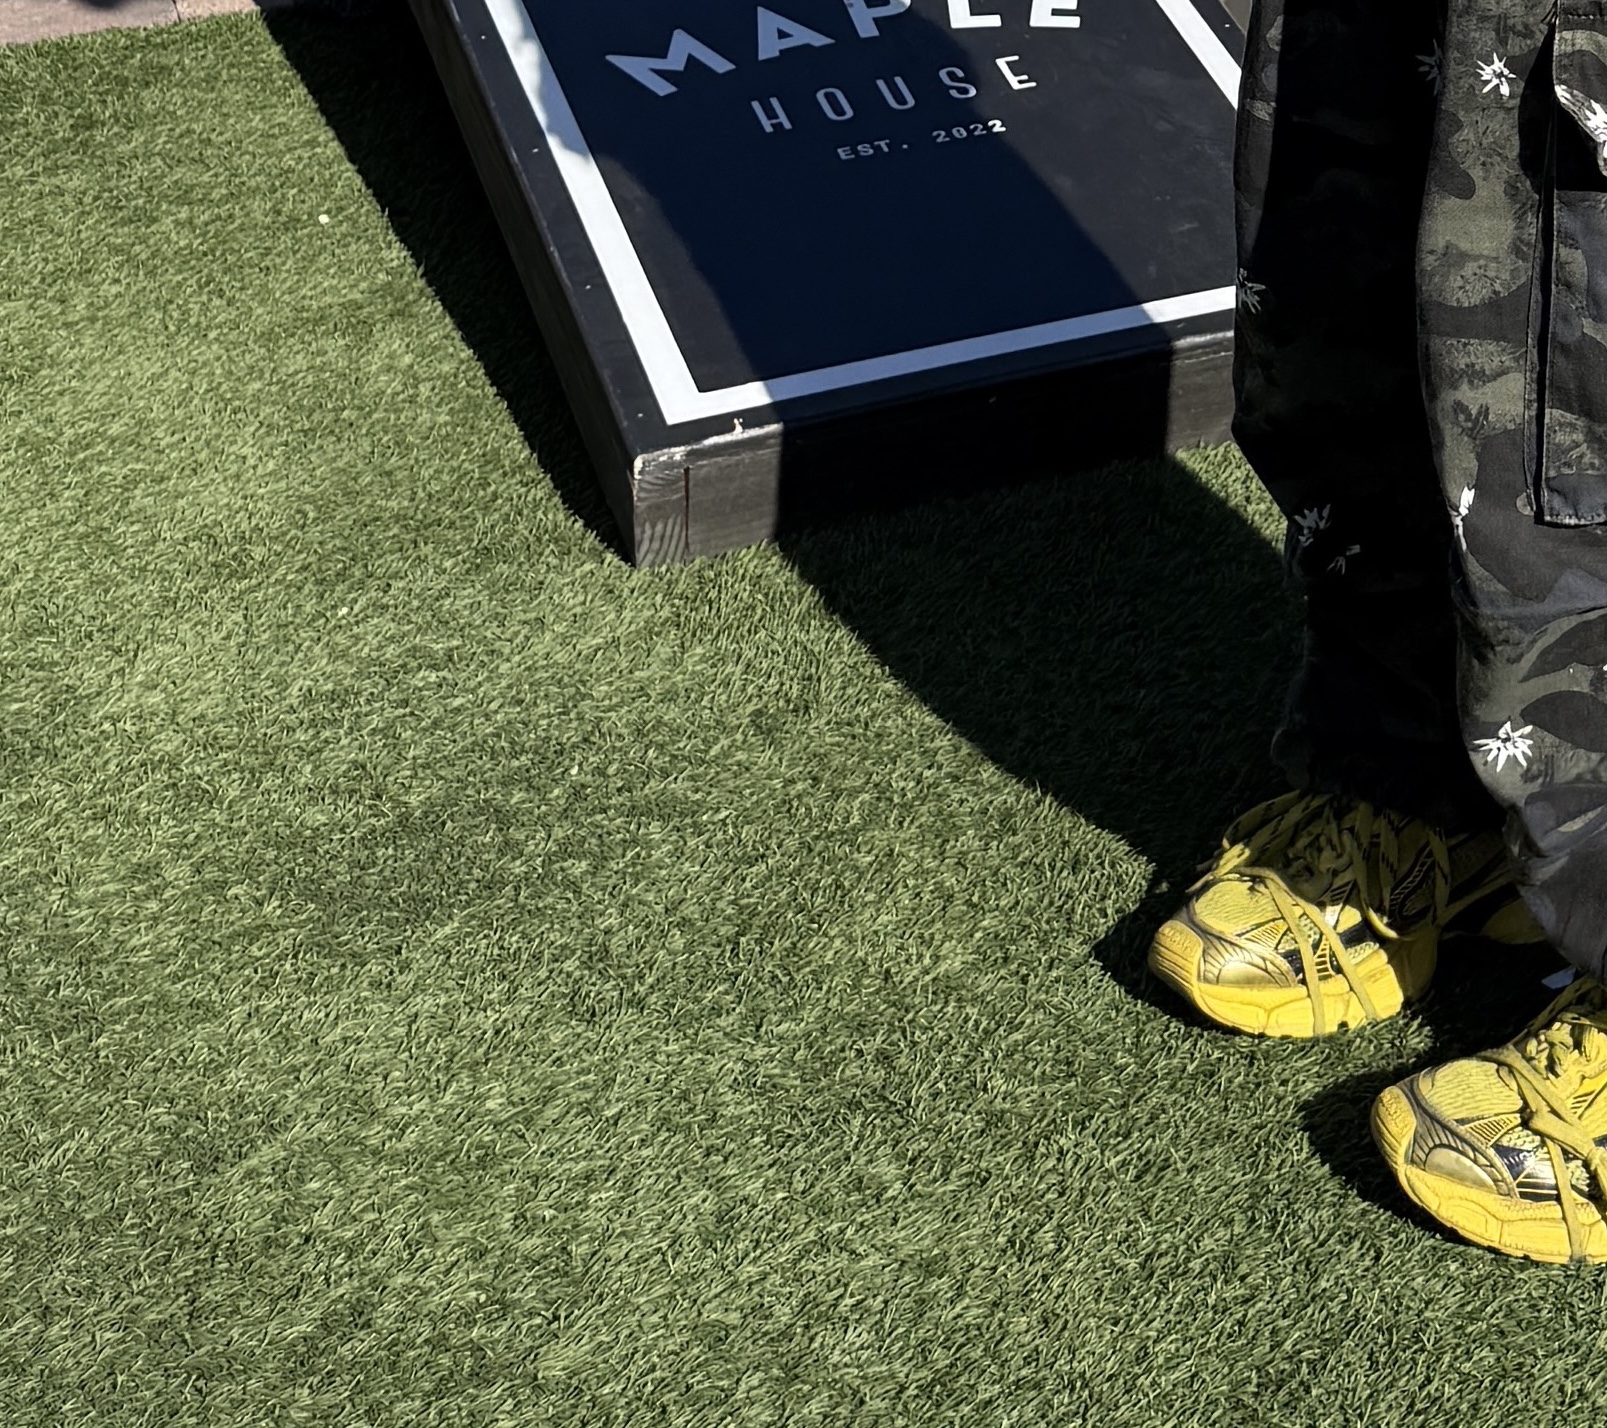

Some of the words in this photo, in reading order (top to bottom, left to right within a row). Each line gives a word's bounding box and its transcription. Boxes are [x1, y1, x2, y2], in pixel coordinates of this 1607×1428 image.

[752, 55, 1037, 133] HOUSE
[837, 140, 908, 160] EST.
[932, 120, 1006, 143] 2022
